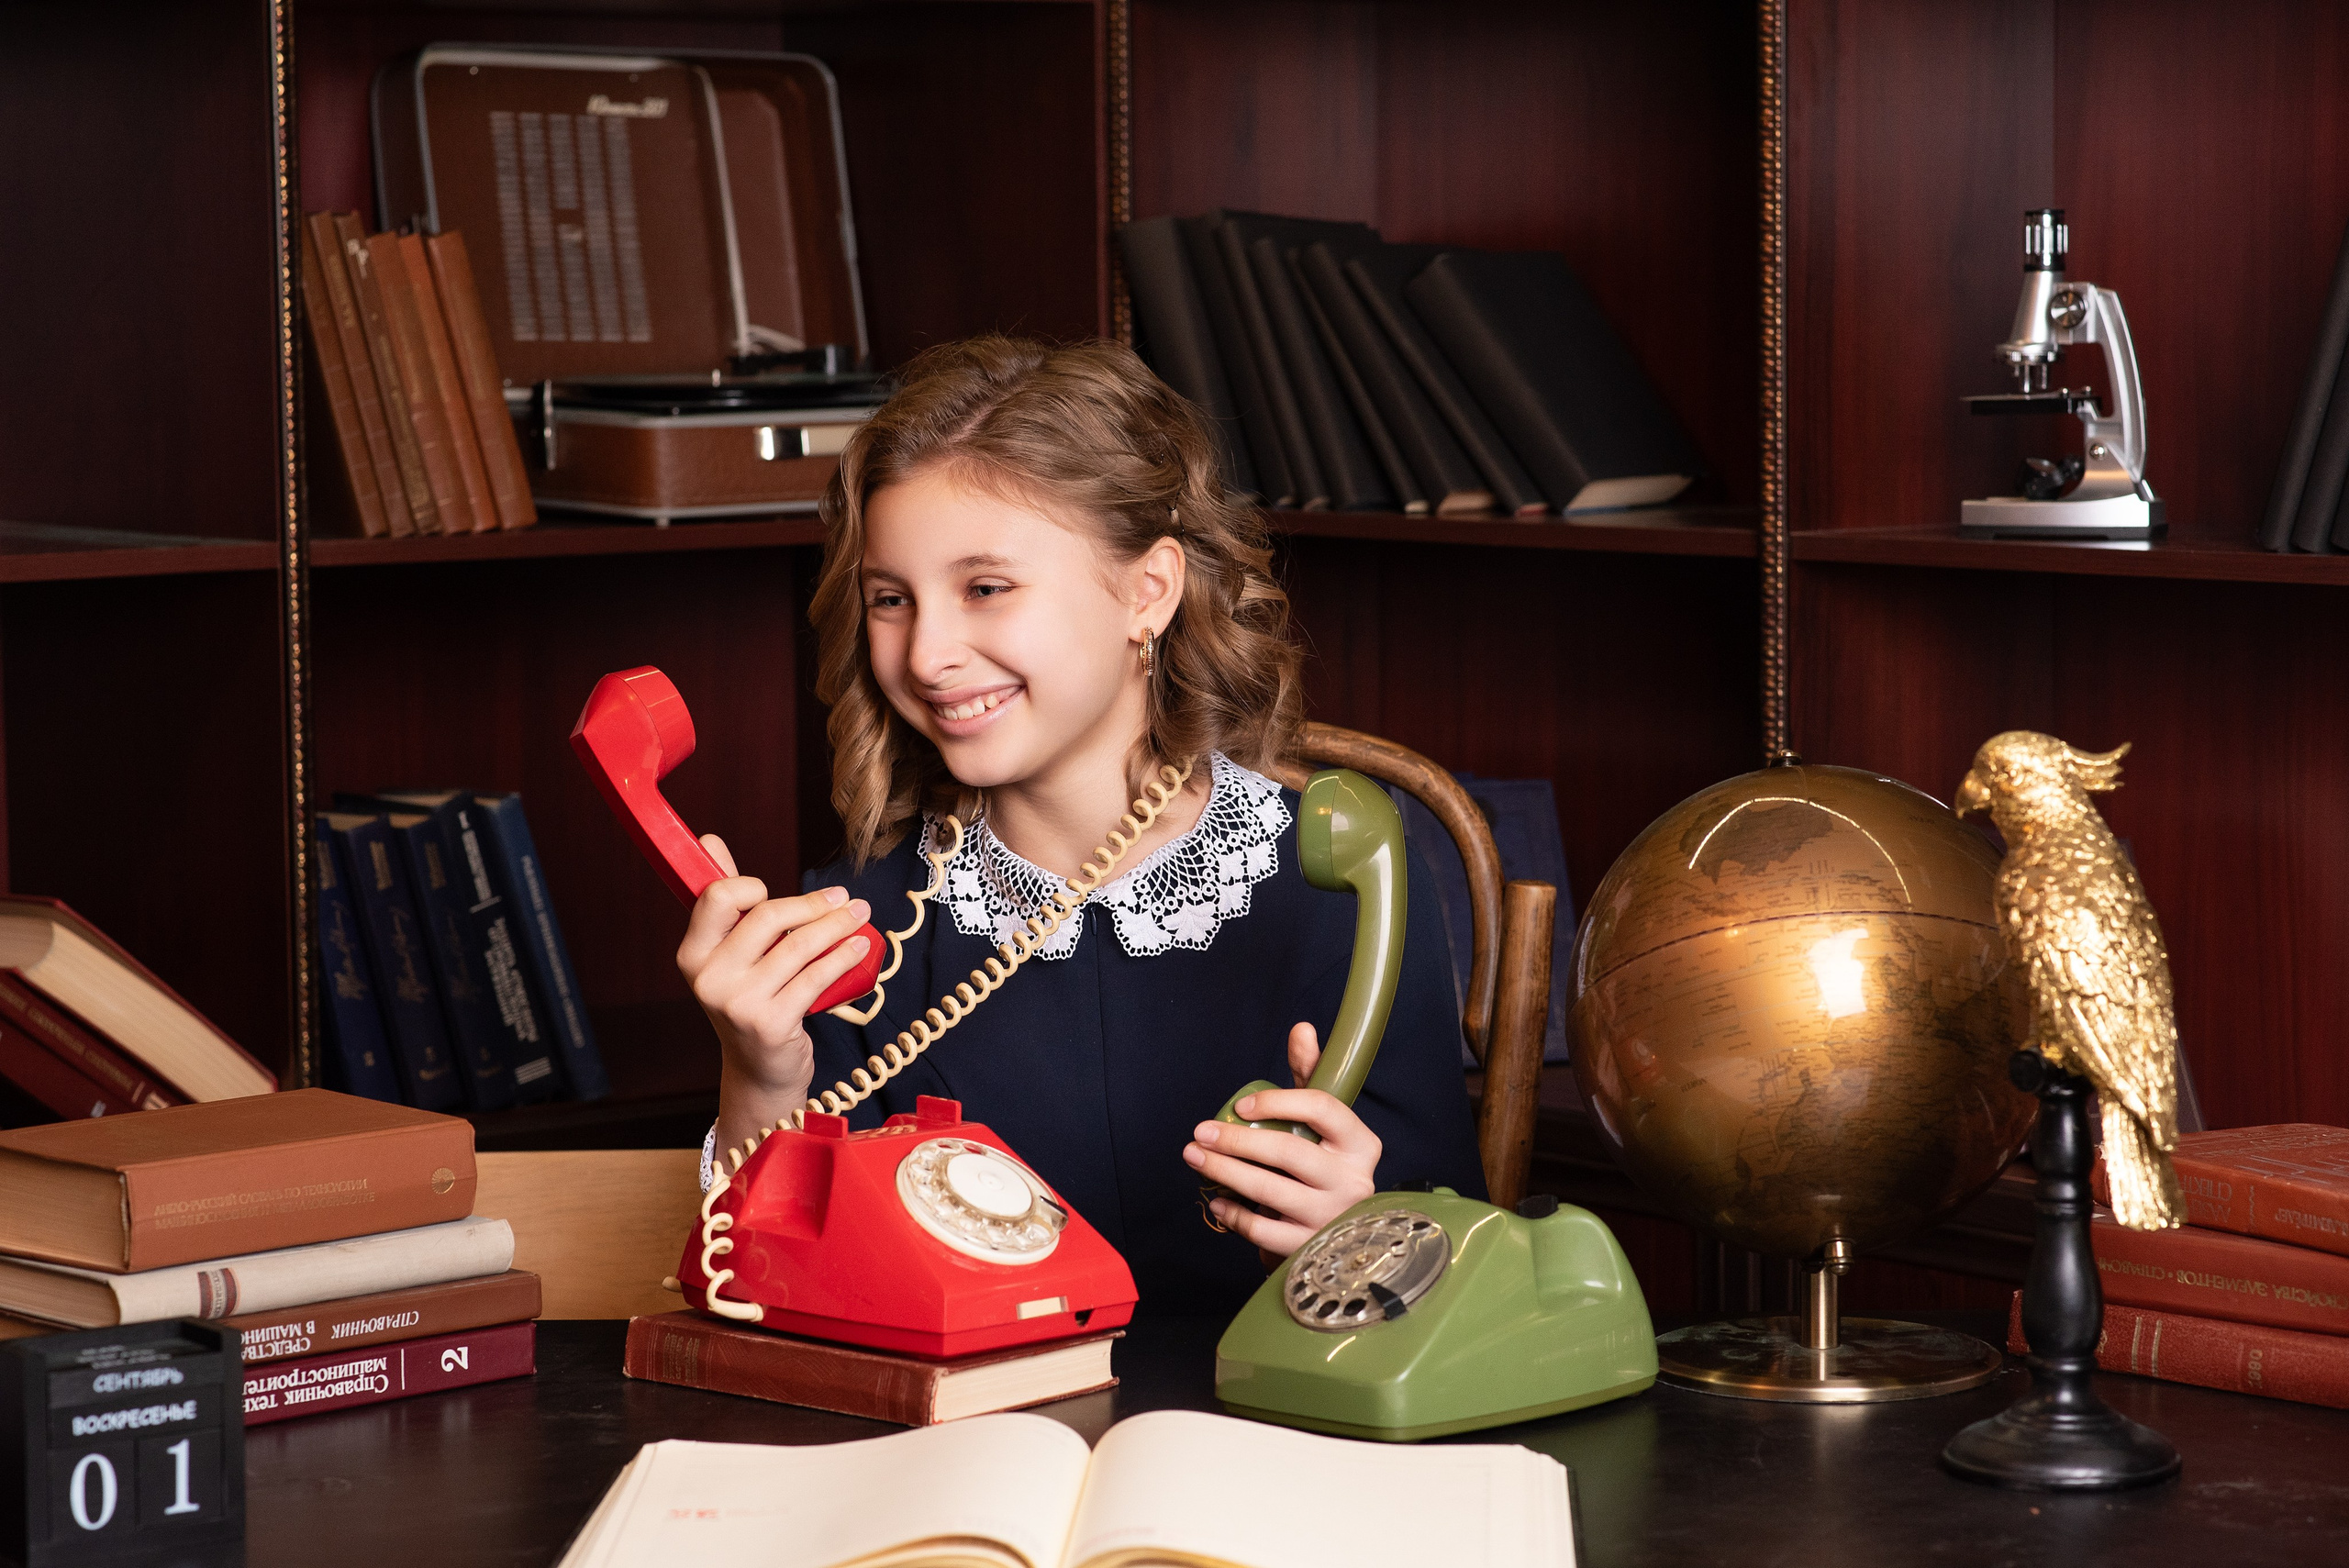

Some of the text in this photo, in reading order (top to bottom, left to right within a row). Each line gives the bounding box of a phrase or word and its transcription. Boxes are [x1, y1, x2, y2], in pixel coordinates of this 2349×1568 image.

[2176, 1271, 2267, 1298] ЭЛЕМЕНТОВ
[306, 1319, 316, 1335] В
[330, 1310, 419, 1340] СПРАВОЧНИК
[440, 1346, 469, 1373] 2
[93, 1367, 184, 1393] СЕНТЯБРЬ
[284, 1374, 389, 1406] Справочник
[72, 1399, 197, 1437] ВОСКРЕСЕНЬЕ
